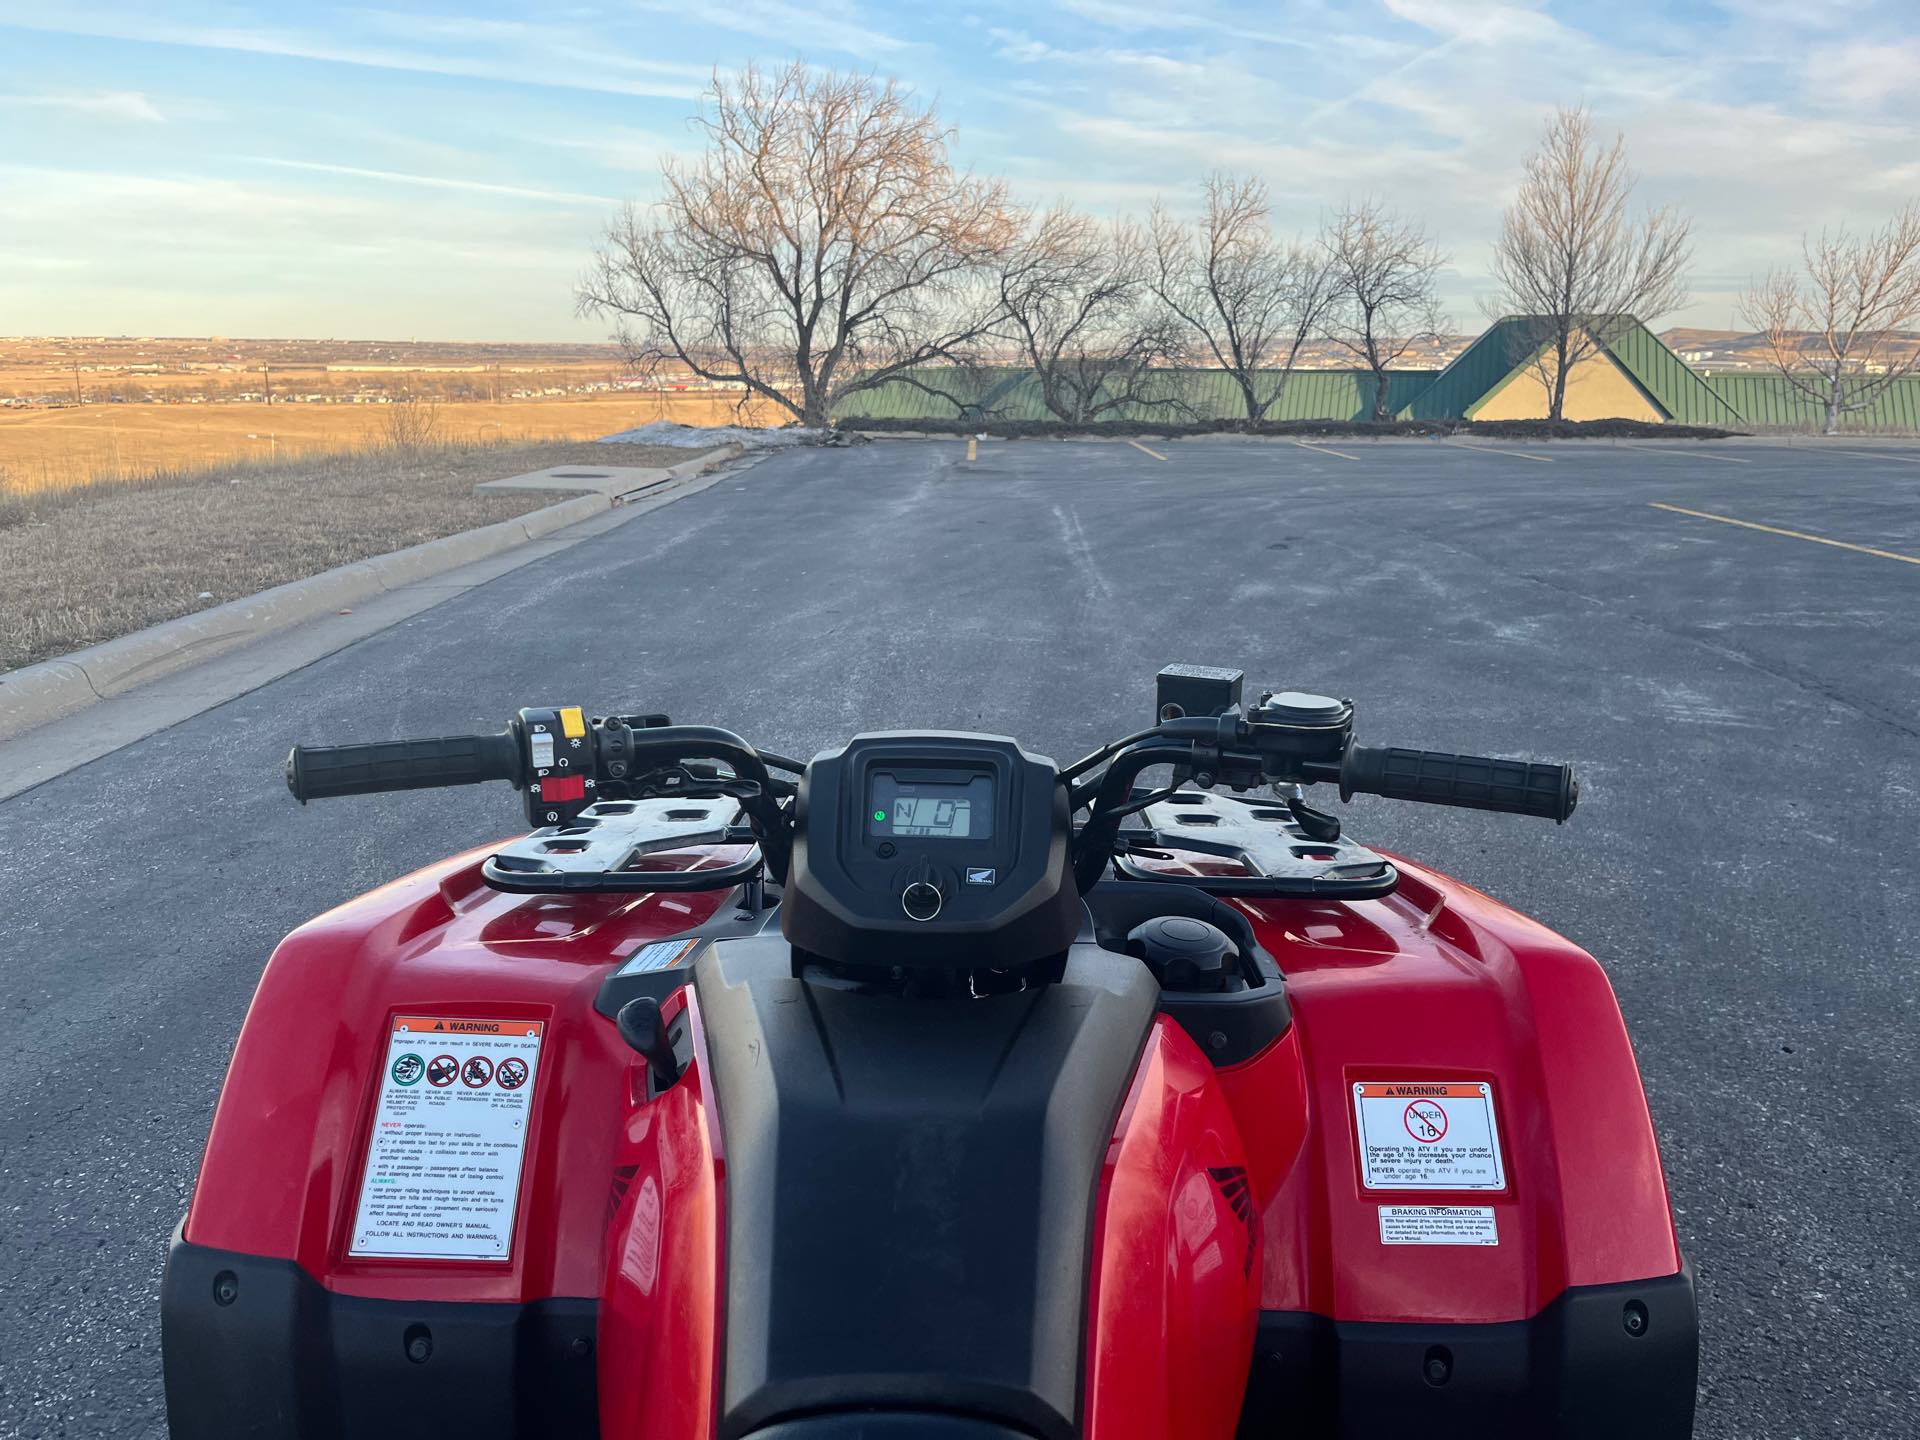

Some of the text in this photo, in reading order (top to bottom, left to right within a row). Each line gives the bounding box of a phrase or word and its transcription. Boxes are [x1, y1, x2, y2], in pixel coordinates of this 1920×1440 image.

[896, 802, 912, 818] N
[934, 800, 956, 826] 0
[448, 1022, 499, 1032] WARNING
[1418, 1125, 1436, 1136] 16
